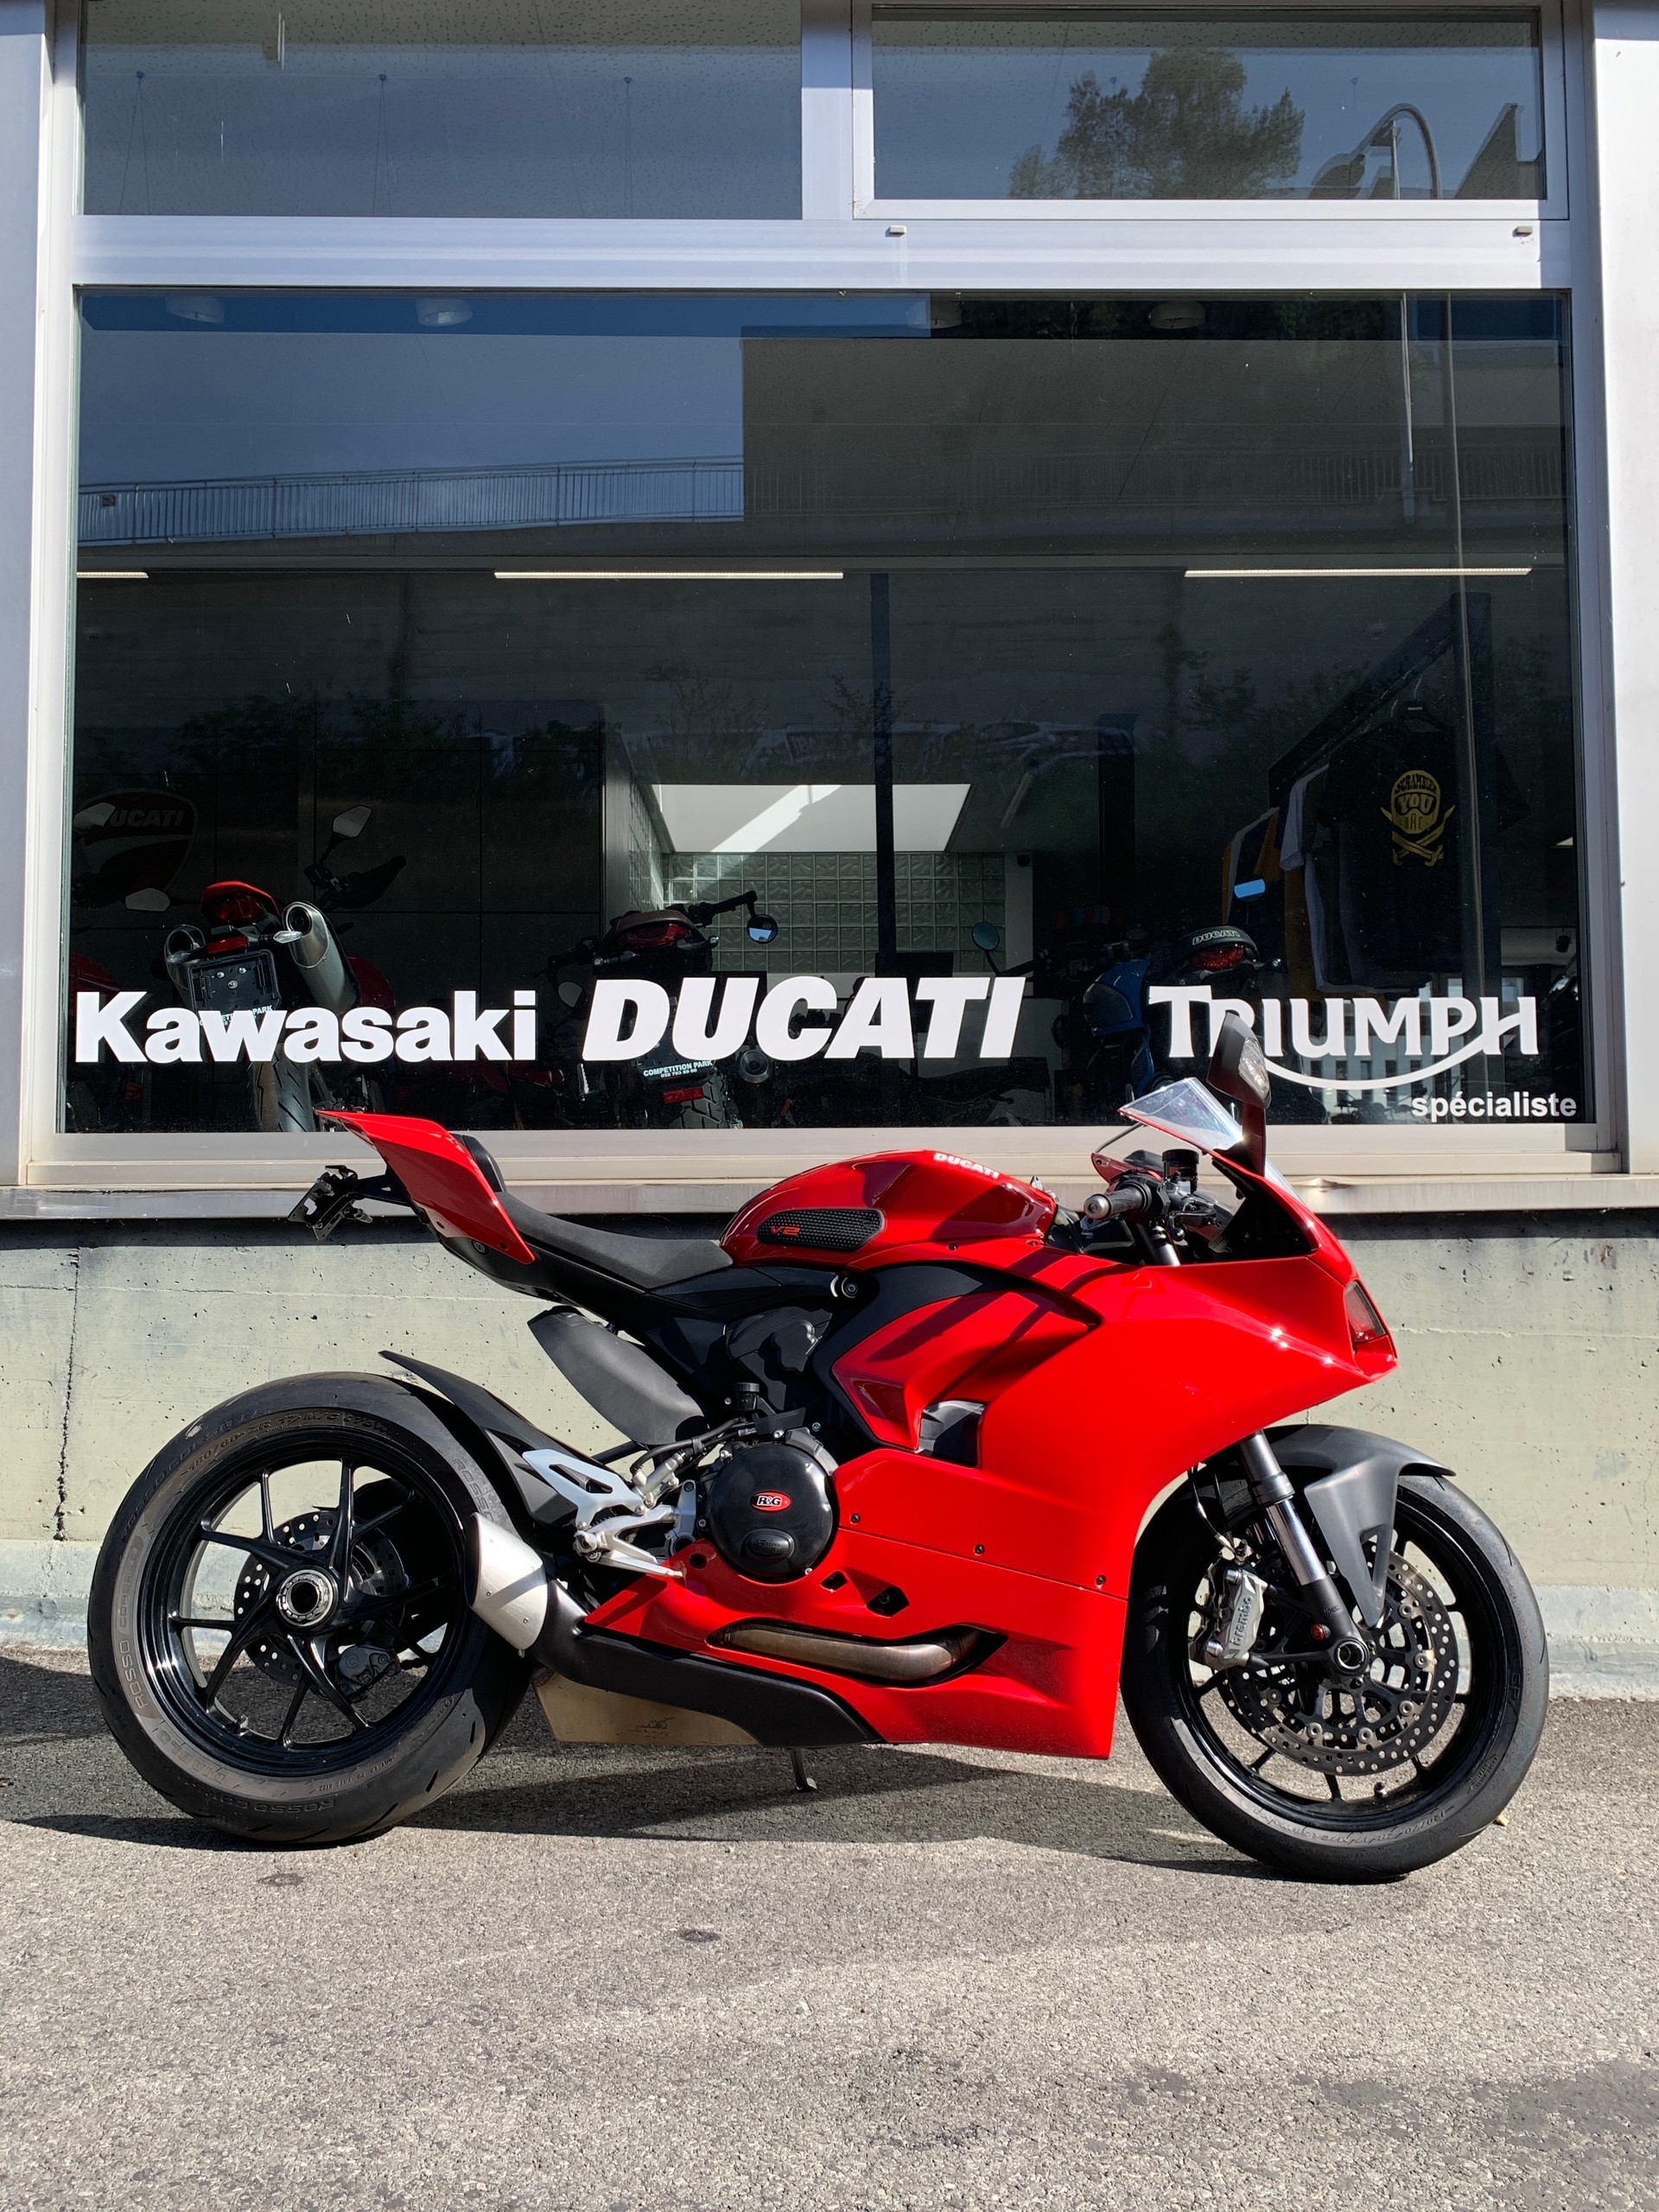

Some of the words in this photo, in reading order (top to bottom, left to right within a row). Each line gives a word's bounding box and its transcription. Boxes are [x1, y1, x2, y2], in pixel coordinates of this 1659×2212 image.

[1397, 793, 1434, 814] YOU
[109, 809, 185, 827] UCATI
[1192, 930, 1241, 945] DUCATI
[75, 990, 536, 1063] Kawasaki
[582, 976, 1026, 1061] DUCATI
[643, 1062, 692, 1077] COMPETITION
[693, 1060, 713, 1069] PARK
[1412, 1091, 1577, 1122] spécialiste
[933, 1153, 1000, 1179] DUCATI
[770, 1225, 801, 1236] V2
[757, 1496, 782, 1507] R&G
[1230, 1595, 1253, 1646] brembo
[119, 1640, 150, 1710] ROSSO
[156, 1730, 226, 1786] DIABLO
